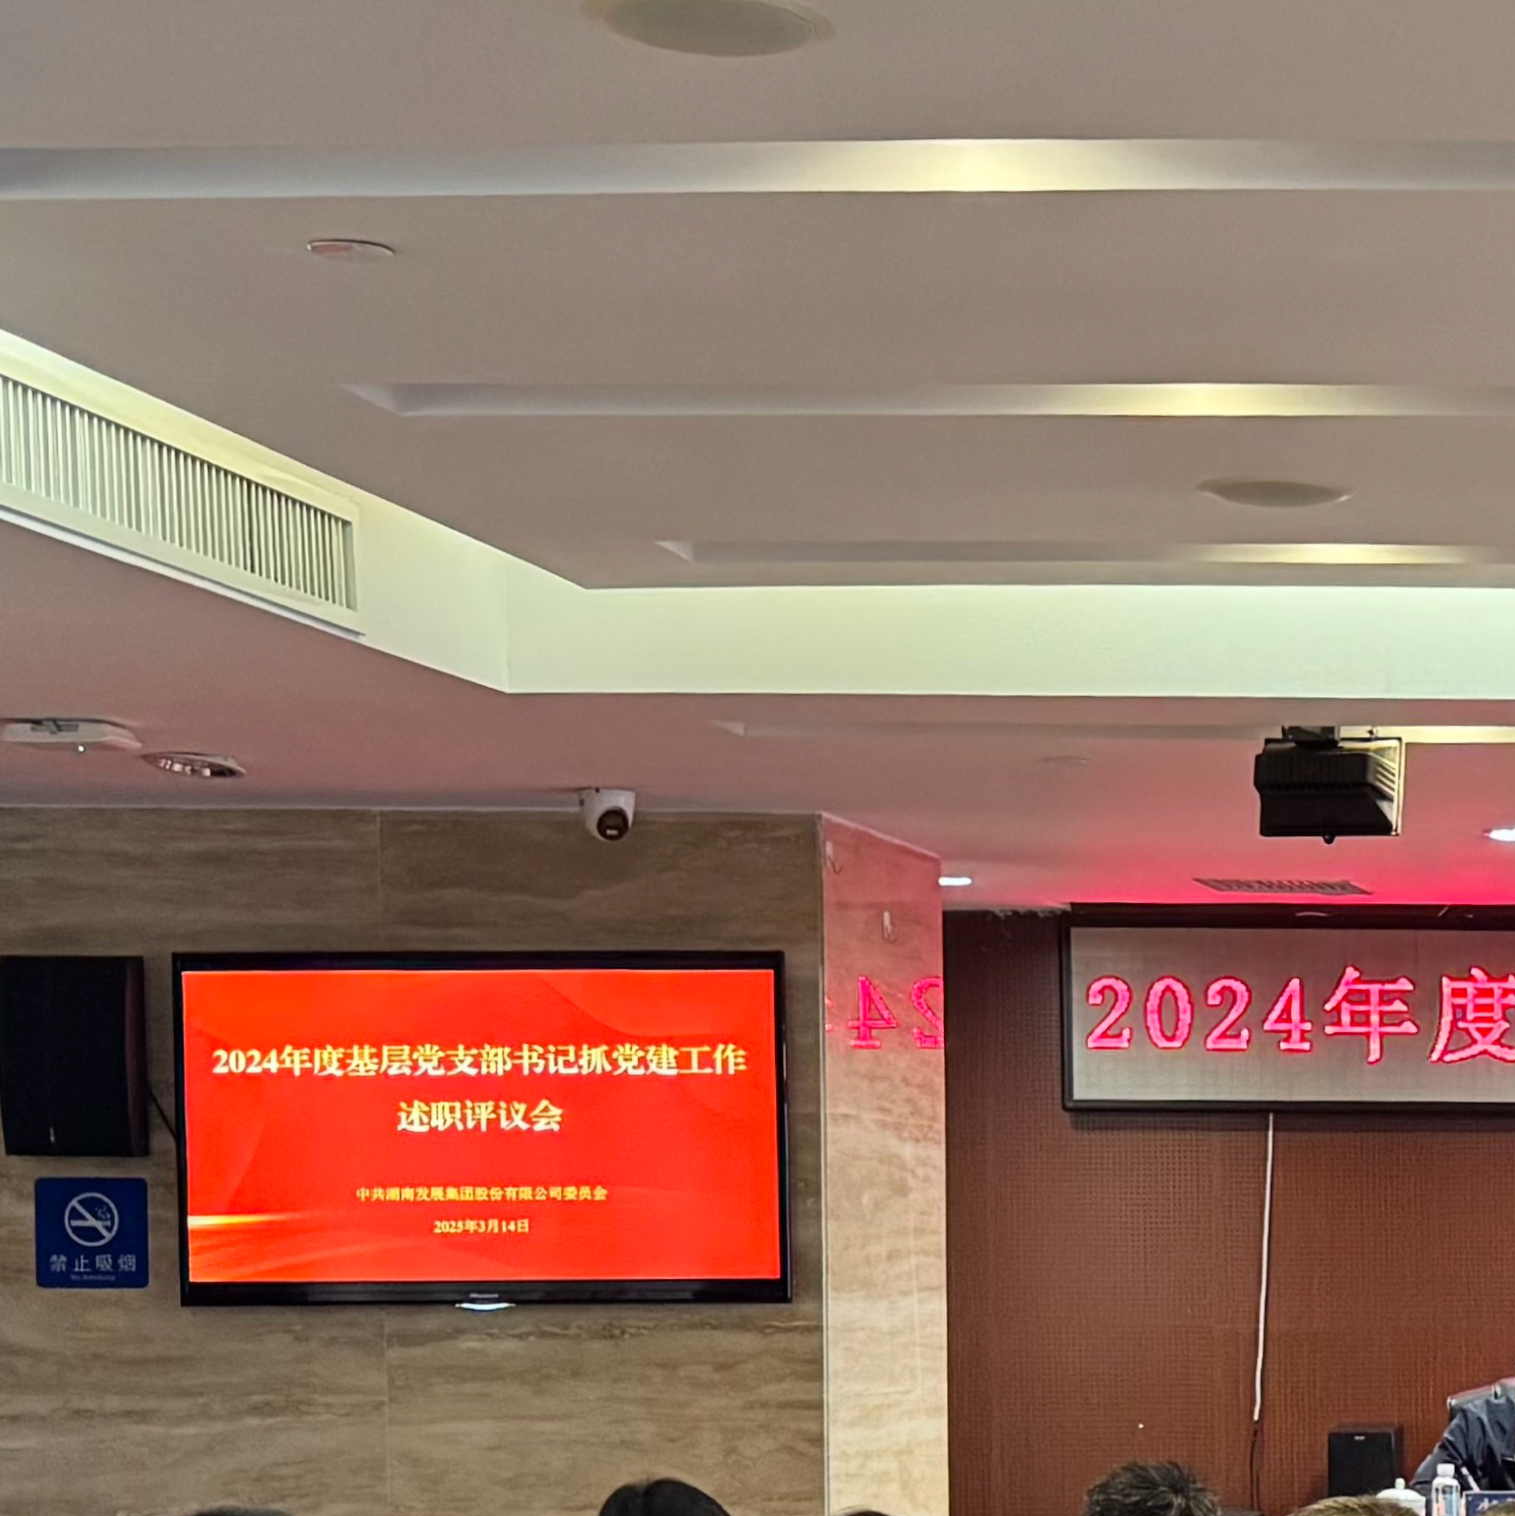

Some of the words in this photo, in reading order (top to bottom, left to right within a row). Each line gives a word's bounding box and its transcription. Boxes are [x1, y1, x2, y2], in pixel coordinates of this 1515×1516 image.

[212, 1042, 747, 1077] 2024年度基层党支部书记抓党建工作
[396, 1099, 563, 1133] 述职评议会
[433, 1218, 530, 1234] 2025年3月14日
[49, 1254, 136, 1272] 禁止吸烟
